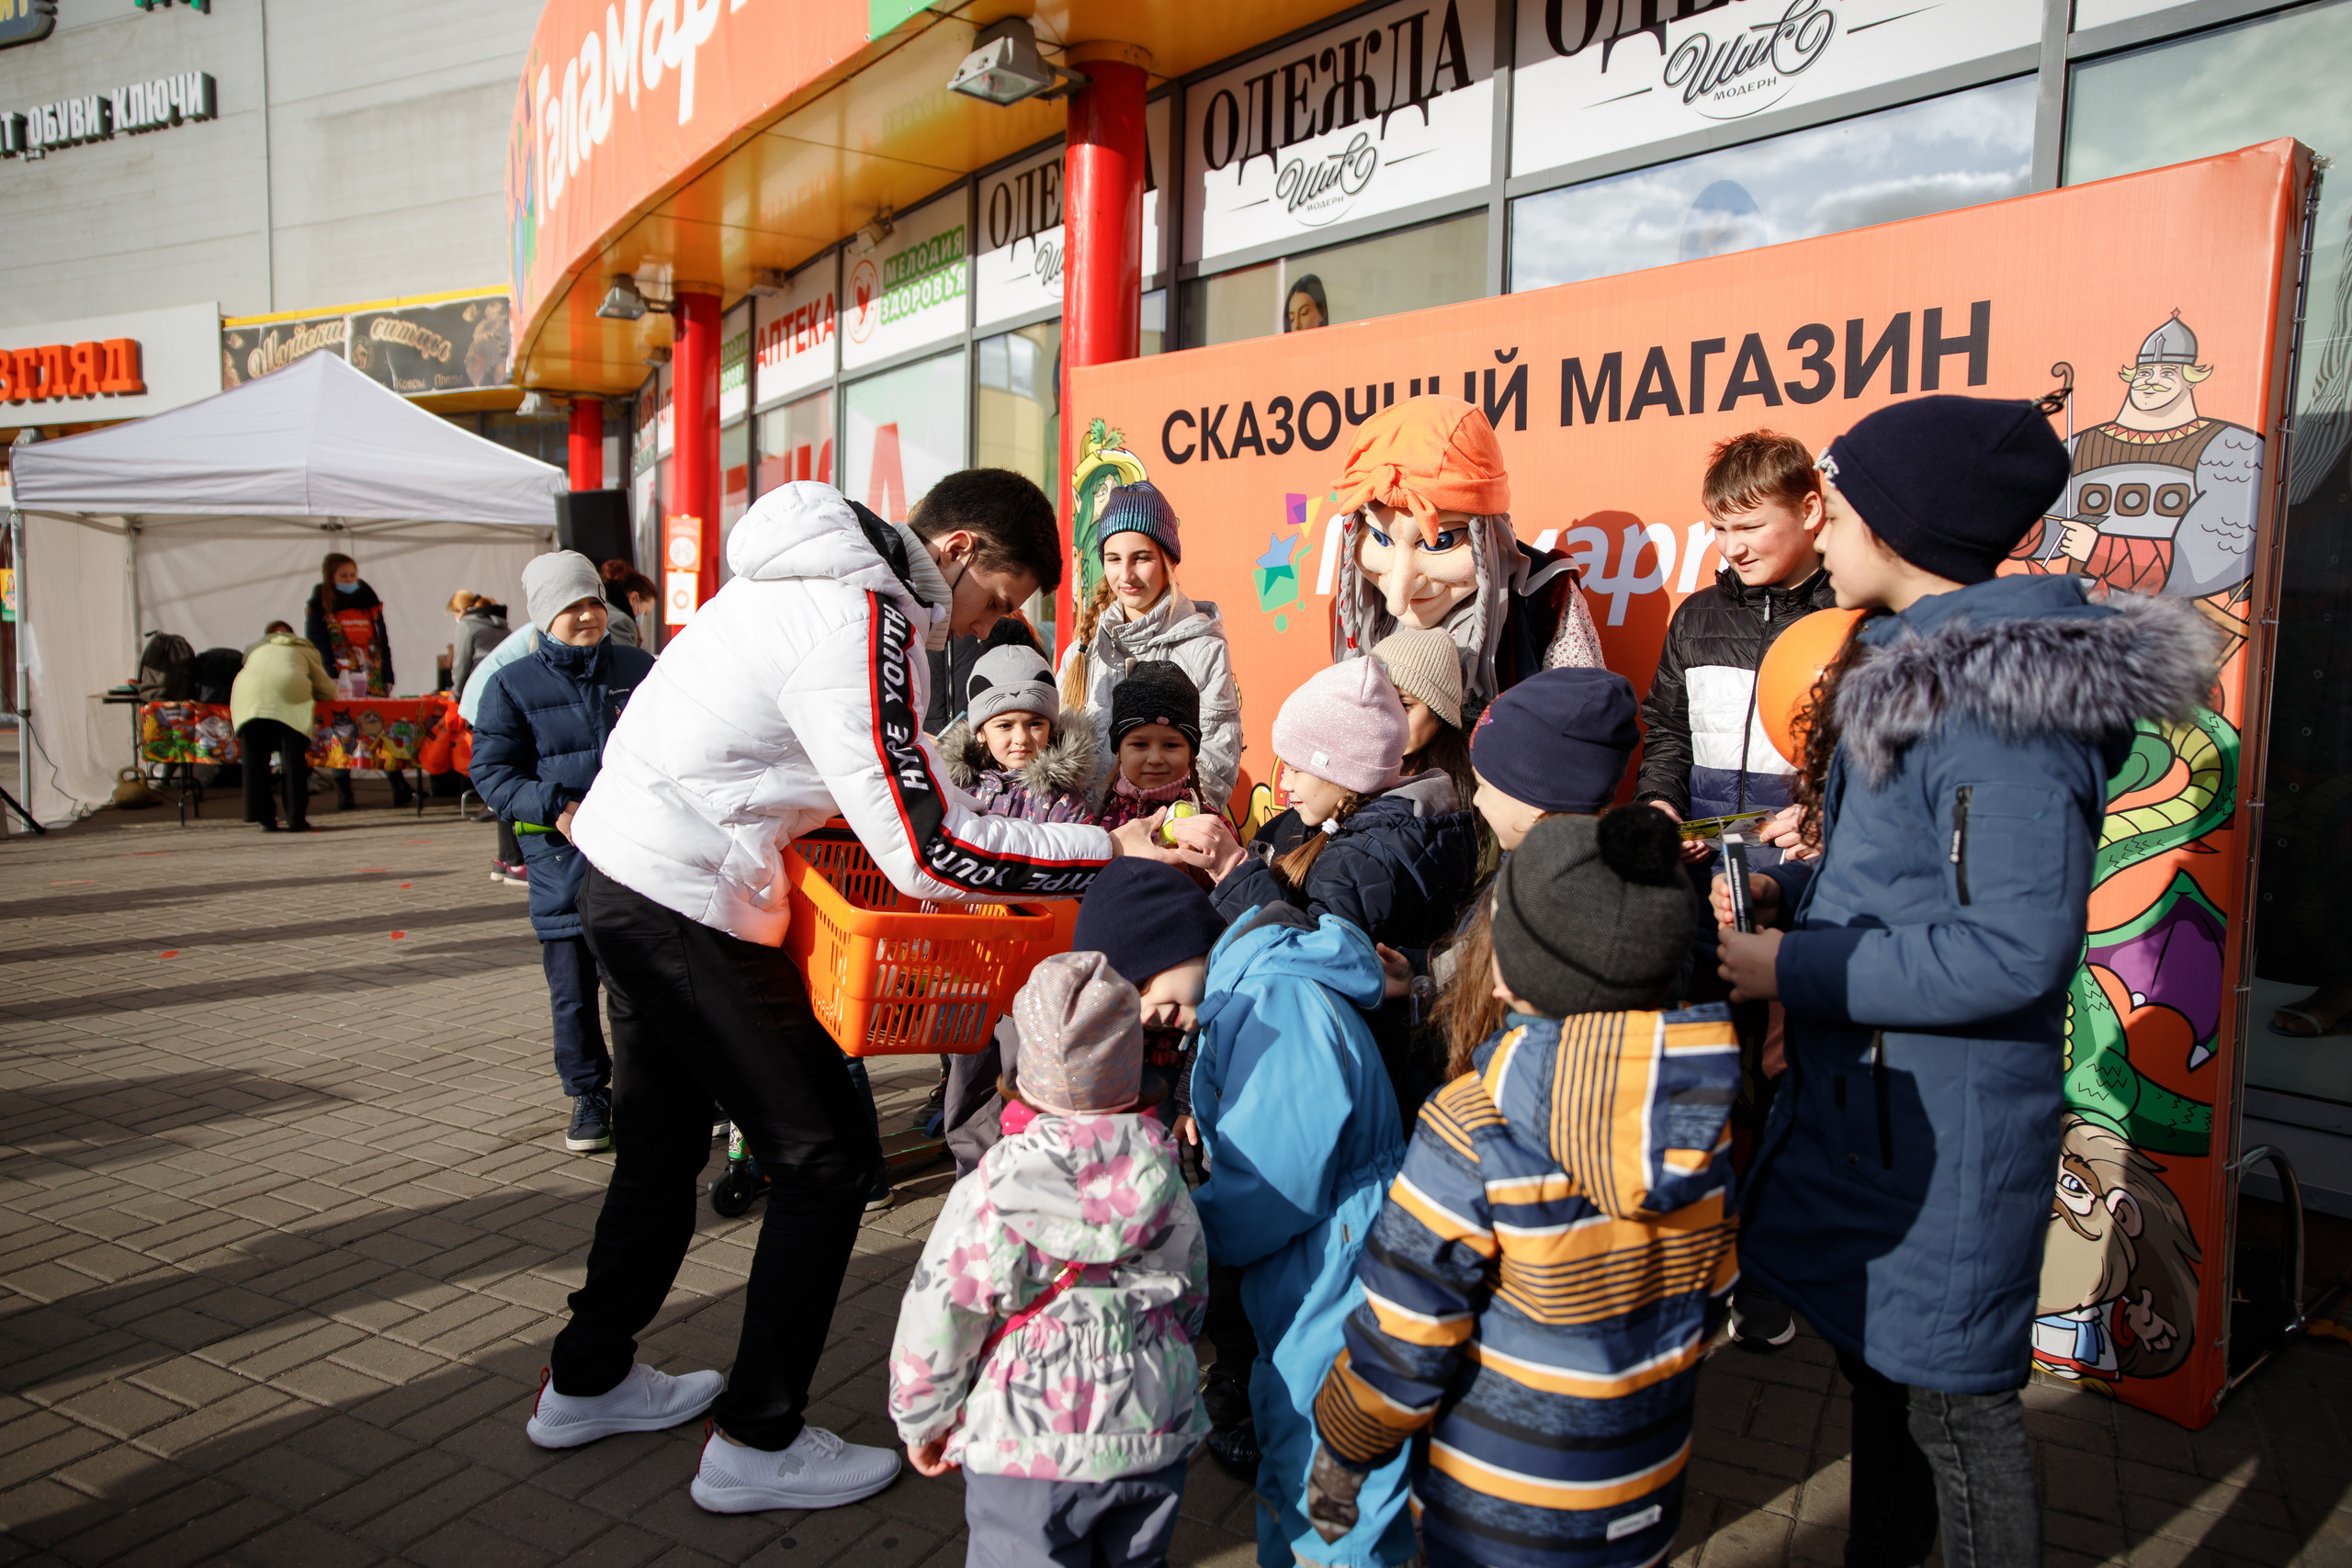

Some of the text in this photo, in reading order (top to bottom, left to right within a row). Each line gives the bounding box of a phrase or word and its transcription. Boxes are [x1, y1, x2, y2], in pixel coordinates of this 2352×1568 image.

[28, 95, 100, 147] ОБУВИ
[111, 70, 204, 133] КЛЮЧИ
[537, 0, 745, 228] Галамар
[1204, 0, 1474, 186] ОДЕЖДА
[1713, 76, 1778, 101] МОДЕРН
[1306, 195, 1345, 212] МОДЕРН
[880, 263, 967, 324] ЗДОРОВЬЯ
[884, 225, 965, 289] МЕЛОДИЯ
[756, 292, 835, 369] АПТЕКА
[1560, 300, 1989, 426] МАГАЗИН
[883, 604, 930, 791] HYPE YOUTH
[1021, 873, 1097, 891] HYPE
